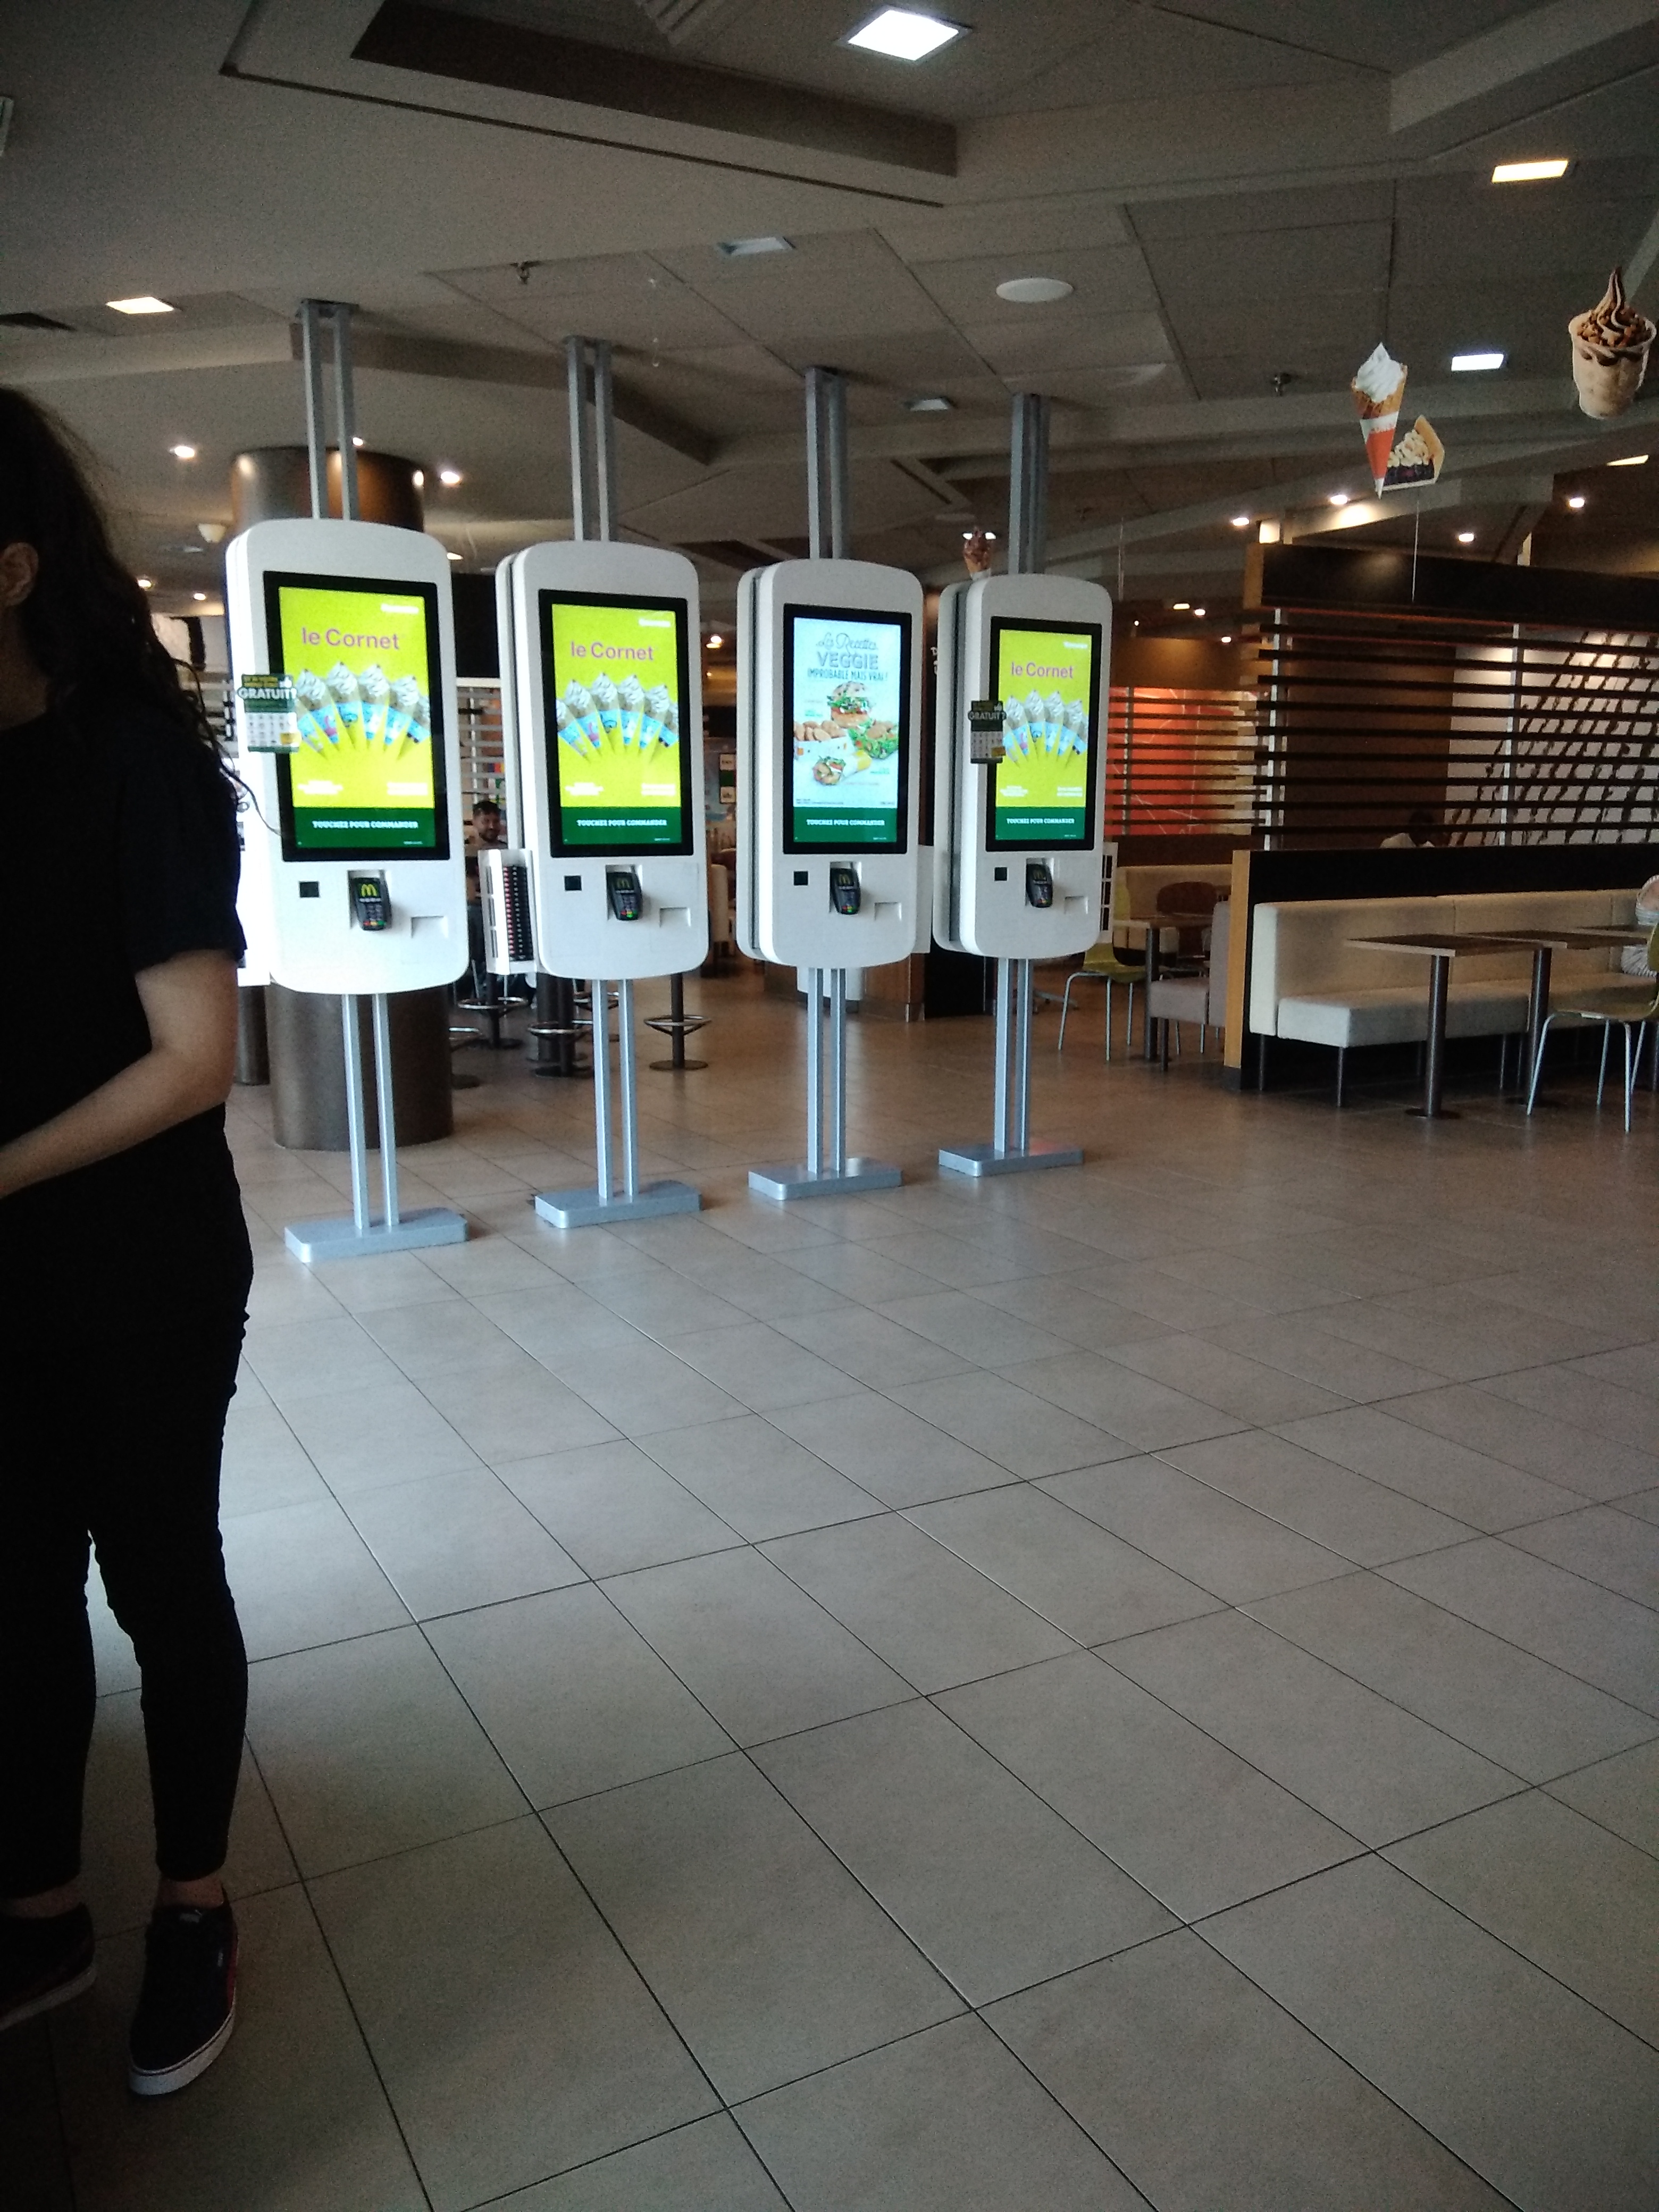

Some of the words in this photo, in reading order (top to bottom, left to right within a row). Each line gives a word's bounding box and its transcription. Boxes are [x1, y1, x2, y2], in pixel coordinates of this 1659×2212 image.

[301, 627, 320, 645] le
[325, 629, 399, 649] Cornet
[571, 641, 586, 657] le
[591, 641, 653, 660] Cornet
[817, 651, 878, 669] VEGGIE
[1012, 661, 1023, 675] le
[1026, 662, 1074, 679] Cornet
